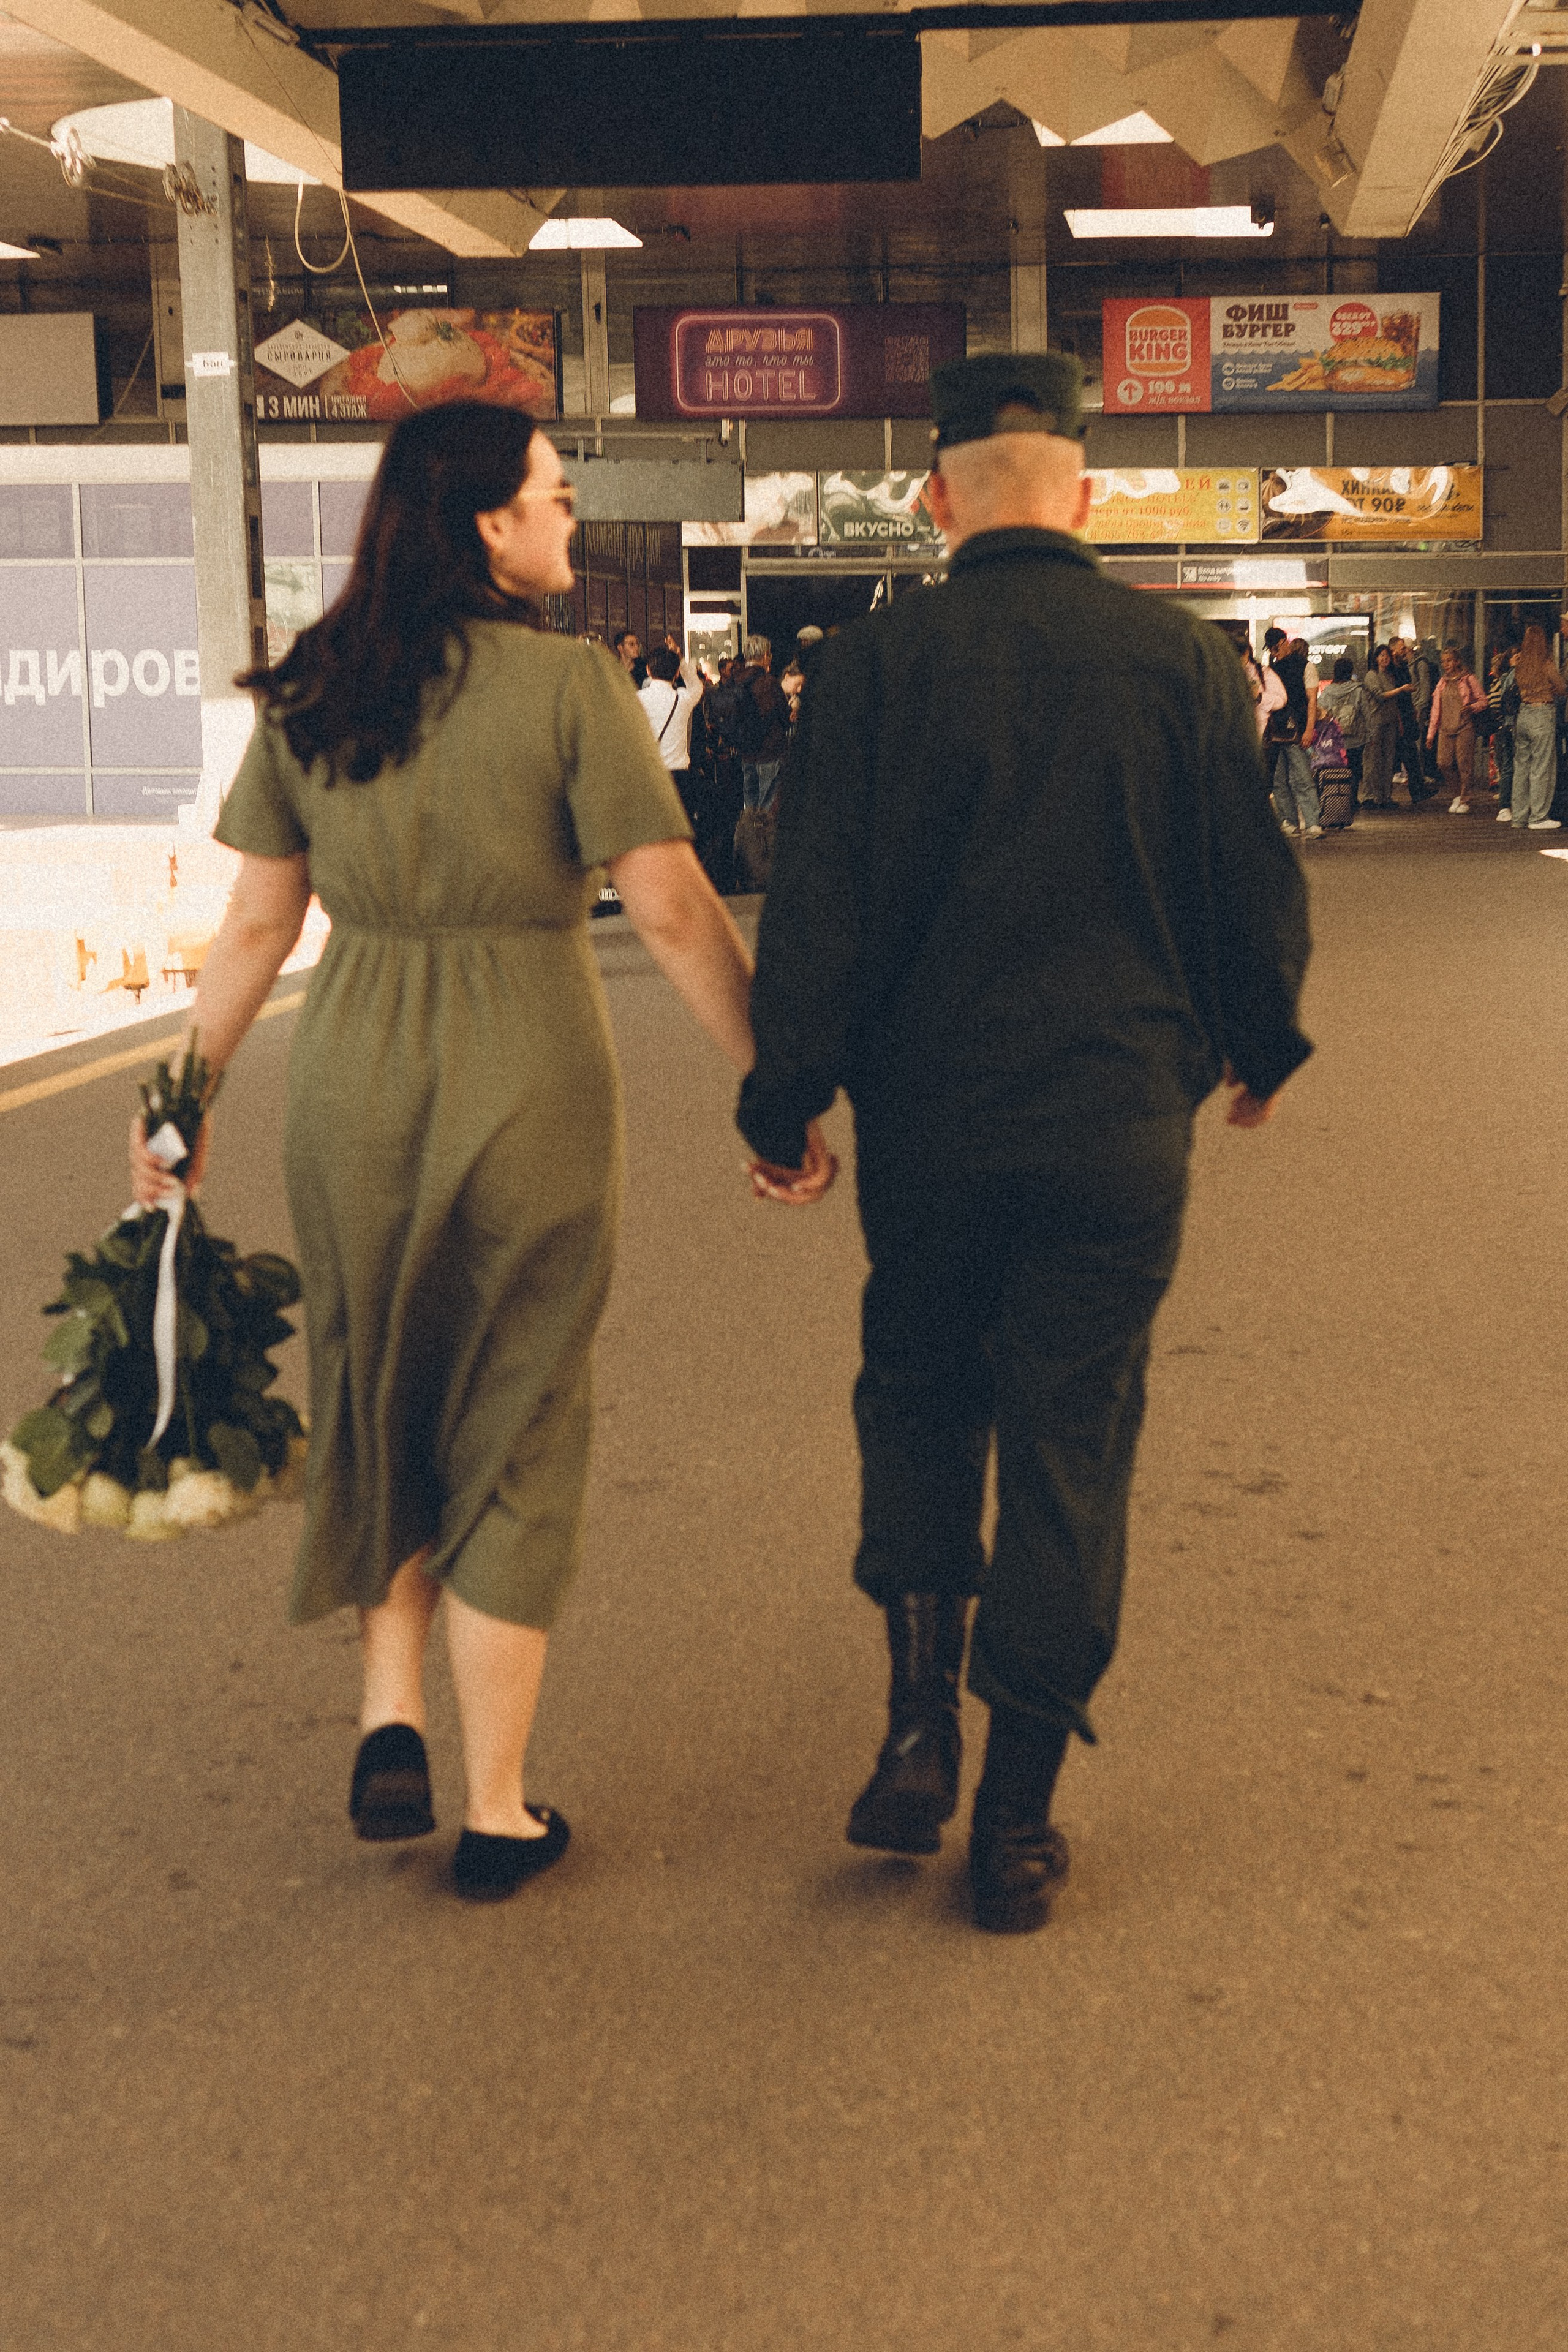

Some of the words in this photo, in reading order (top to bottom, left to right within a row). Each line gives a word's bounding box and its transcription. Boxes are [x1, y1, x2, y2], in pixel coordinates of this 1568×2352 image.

[1226, 303, 1289, 321] ФИШ
[1129, 329, 1188, 341] BURGER
[1223, 323, 1296, 338] БУРГЕР
[706, 328, 813, 353] ДРУЗЬЯ
[268, 350, 331, 362] СЫРОВАРНЯ
[1129, 342, 1188, 360] KING
[706, 369, 816, 402] HOTEL
[1148, 380, 1175, 394] 100
[268, 395, 279, 419] 3
[283, 395, 320, 419] МИН
[339, 404, 368, 419] ЭТАЖ
[844, 522, 914, 537] ВКУСНО
[0, 649, 200, 708] диров
